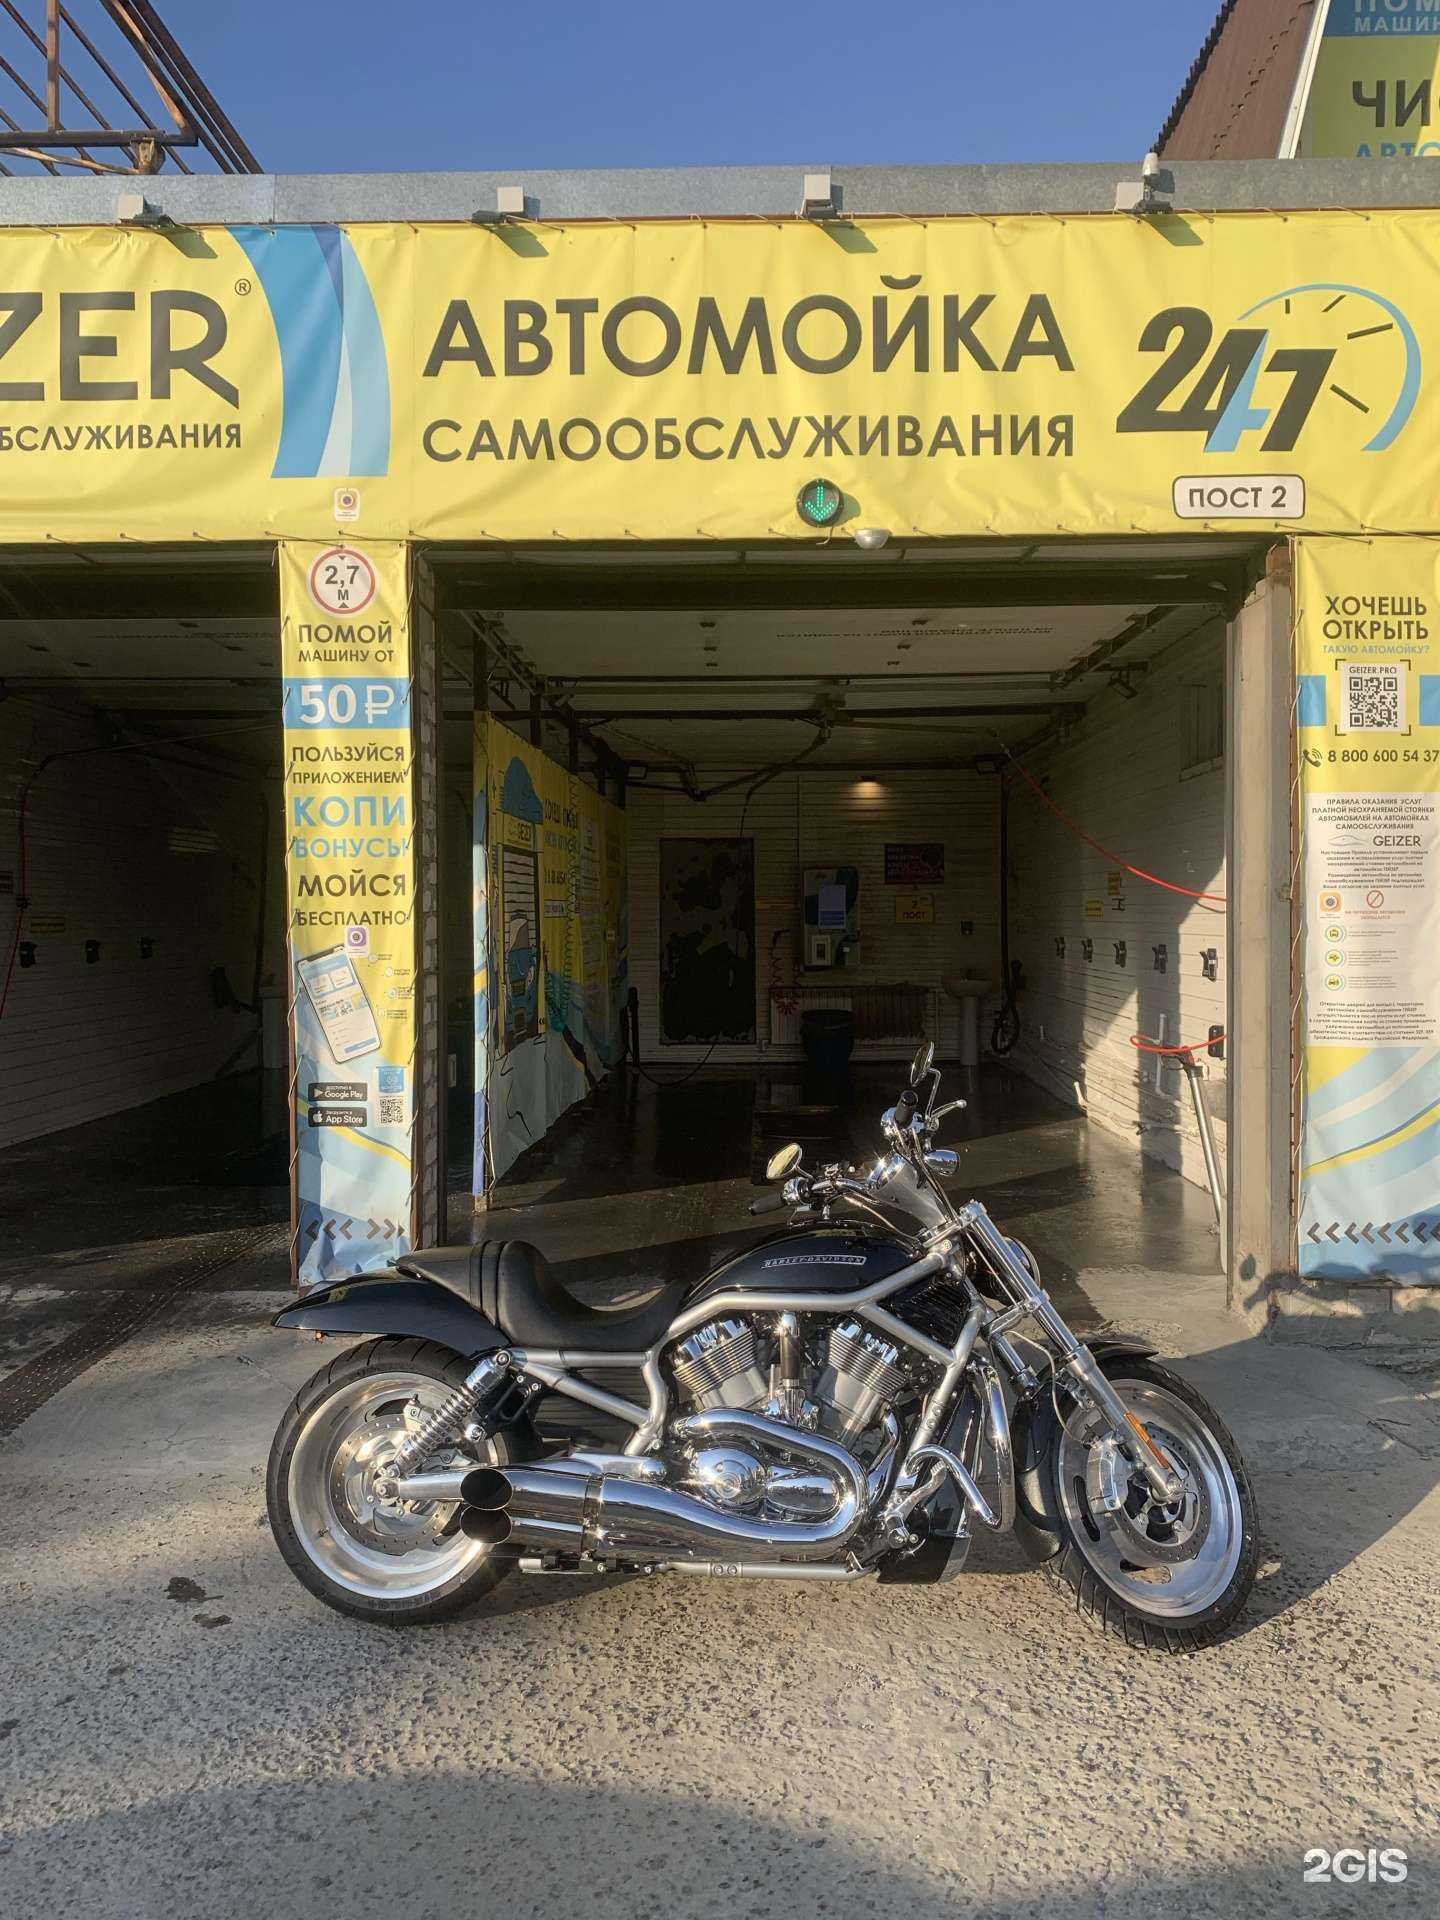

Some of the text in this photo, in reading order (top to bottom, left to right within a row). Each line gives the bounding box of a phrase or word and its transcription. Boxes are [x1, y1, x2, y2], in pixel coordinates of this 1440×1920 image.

[1352, 79, 1440, 127] ЧИ
[422, 275, 1076, 378] АВТОМОЙКА
[0, 423, 242, 452] БСЛУЖИВАНИЯ
[422, 412, 1075, 462] САМООБСЛУЖИВАНИЯ
[1188, 486, 1287, 510] ПОСТ 2
[324, 564, 360, 588] 2,7
[337, 589, 349, 601] М
[1325, 596, 1428, 616] ХОЧЕШЬ
[298, 620, 393, 644] ПОМОЙ
[1322, 619, 1429, 640] ОТКРЫТЬ
[298, 649, 394, 663] МАШИНУ ОТ
[291, 742, 405, 763] ПОЛЬЗУЙСЯ
[1327, 749, 1440, 763] 8 800 600 54 37
[292, 771, 404, 785] ПРИЛОЖЕНИЕМ
[294, 795, 405, 828] КОПИ
[294, 837, 406, 859] БОНУСЫ
[1372, 835, 1421, 847] GEIZER
[297, 868, 406, 897] МОЙСЯ
[297, 910, 407, 926] БЕСПЛАТНО
[324, 1090, 349, 1099] Google
[325, 1115, 363, 1124] App Store
